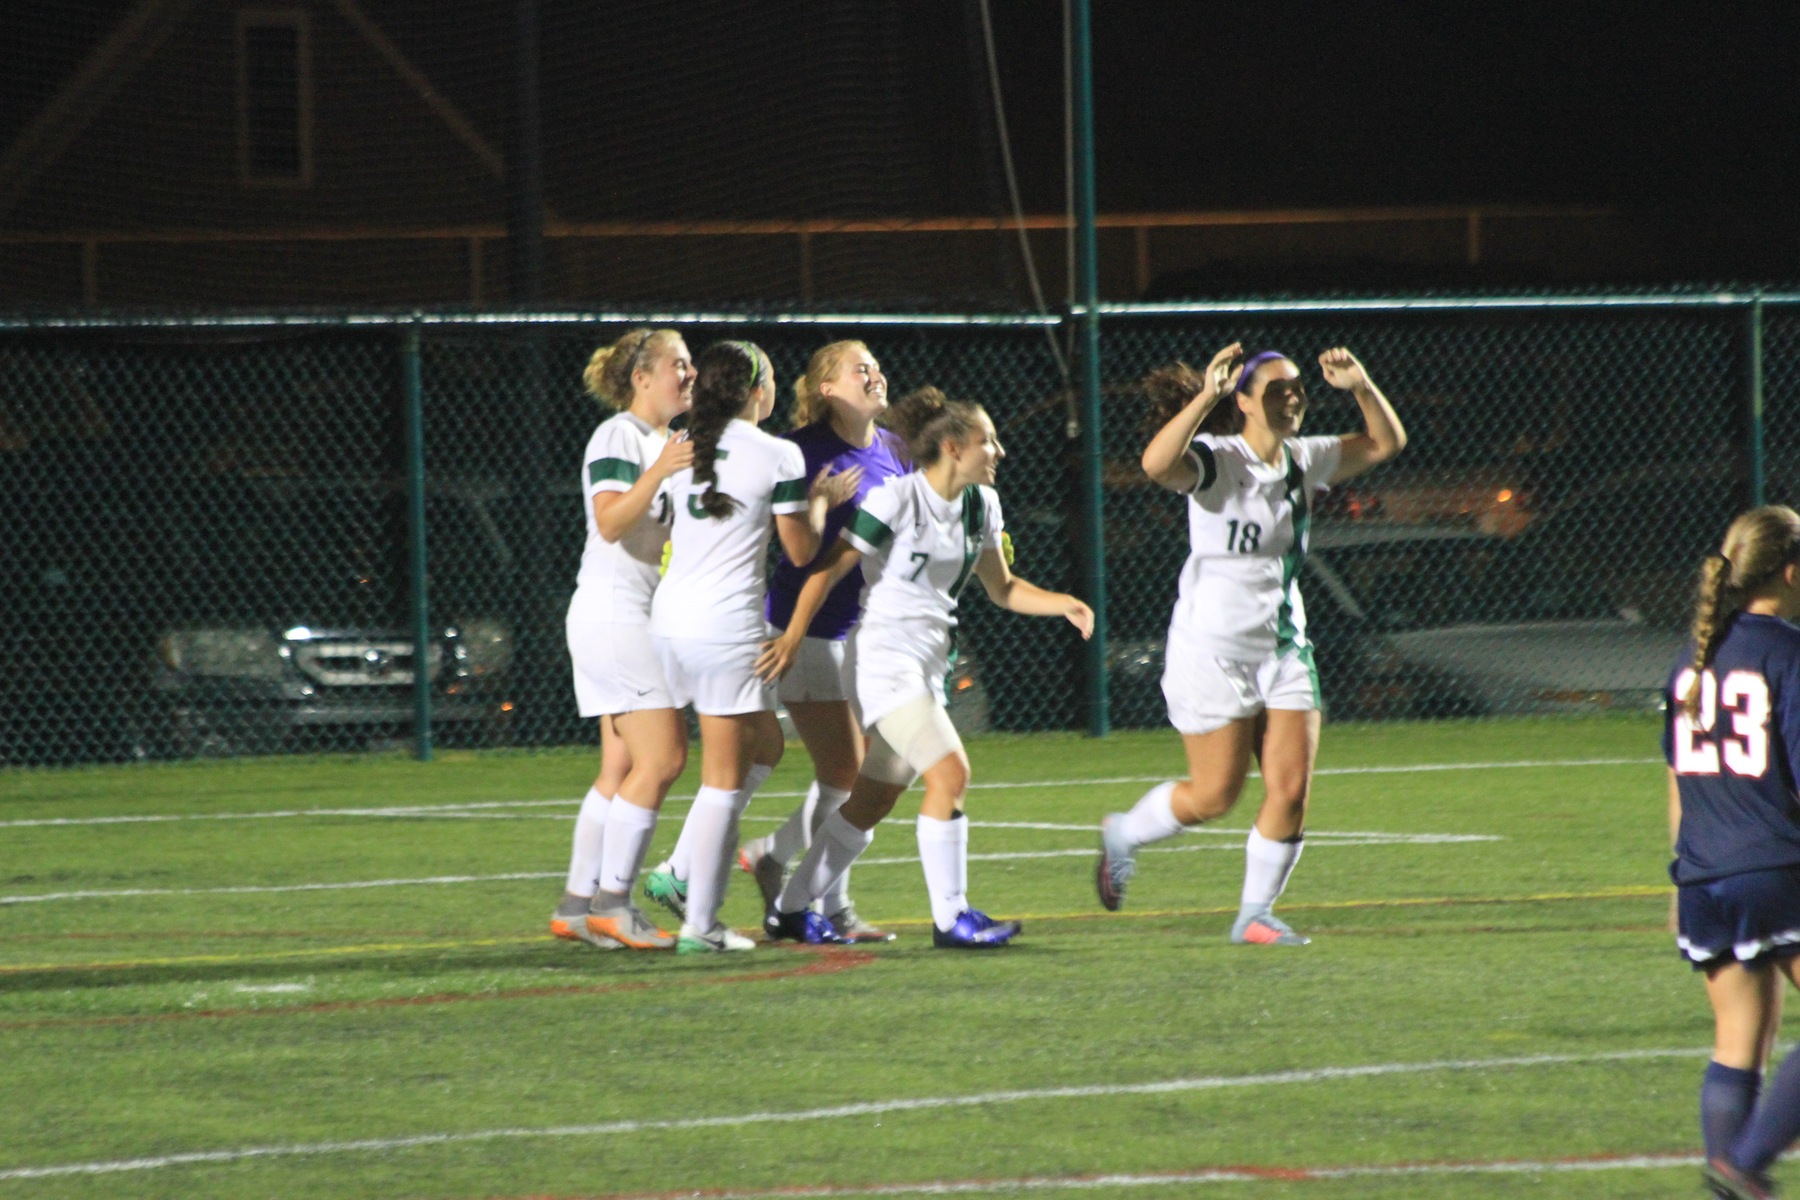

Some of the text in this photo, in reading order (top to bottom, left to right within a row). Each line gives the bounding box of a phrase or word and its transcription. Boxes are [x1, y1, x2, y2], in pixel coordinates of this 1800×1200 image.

[1227, 519, 1262, 554] 18
[910, 552, 929, 582] 7
[1674, 667, 1770, 779] 23
